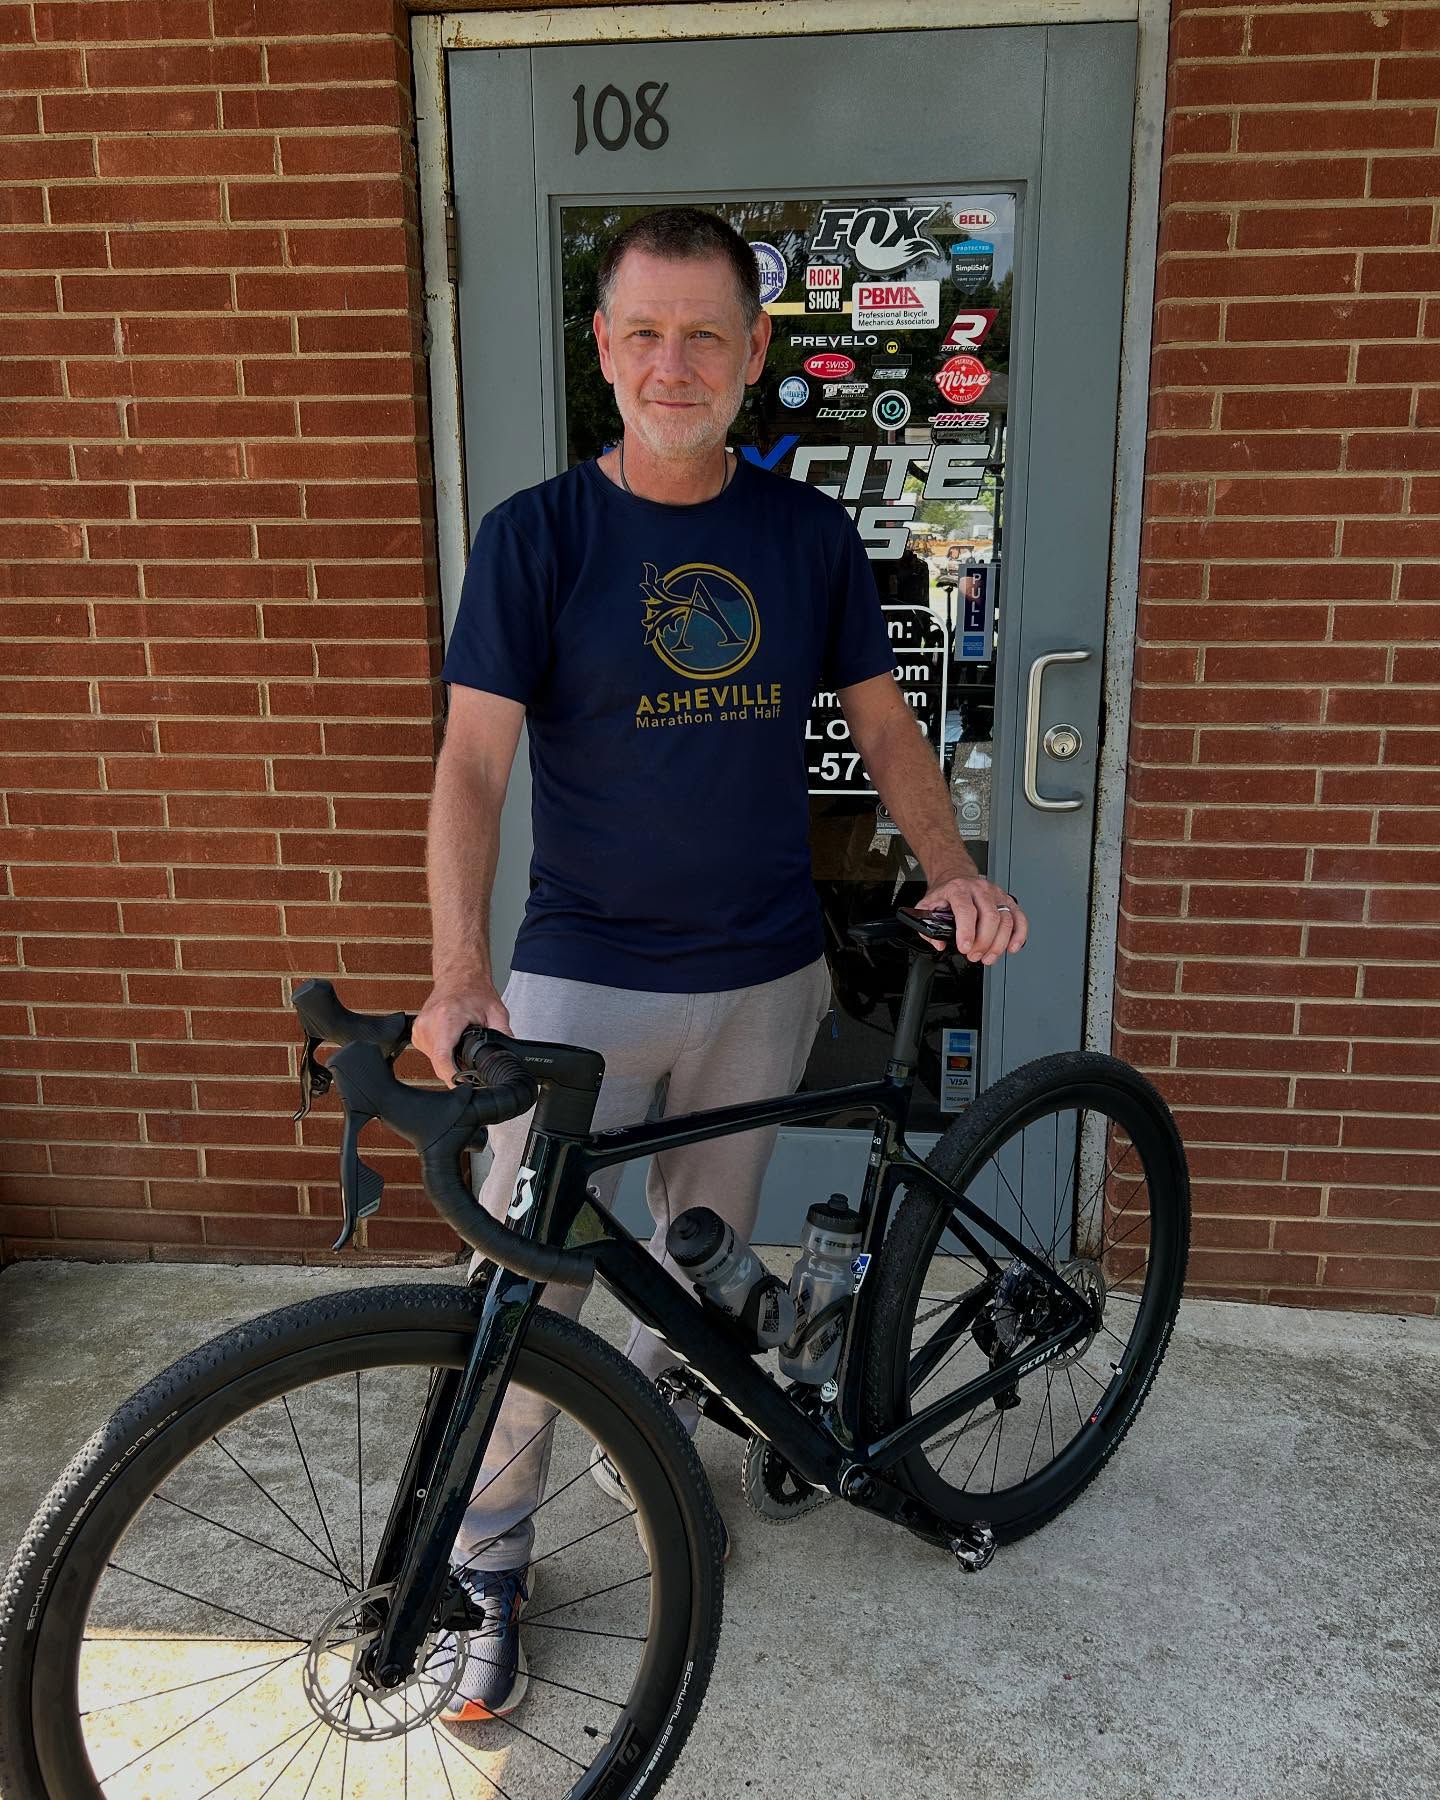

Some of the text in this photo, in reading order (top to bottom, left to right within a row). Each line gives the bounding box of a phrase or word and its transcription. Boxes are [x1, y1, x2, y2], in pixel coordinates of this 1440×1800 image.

[572, 81, 669, 155] 108
[959, 213, 990, 226] BELL
[811, 206, 942, 256] FOX
[809, 268, 840, 287] ROCK
[955, 264, 990, 273] SimpliSafe
[808, 290, 840, 310] SHOX
[858, 286, 921, 305] PBMA
[858, 310, 928, 321] Professional Bicycle
[858, 318, 935, 327] Mechanics Association
[790, 334, 878, 348] PREVELO
[825, 360, 850, 370] SWISS
[816, 407, 868, 421] hope
[934, 412, 987, 421] JAMIS
[935, 420, 987, 428] BIKES
[970, 573, 982, 627] PULL
[636, 683, 782, 716] ASHEVILLE
[636, 704, 782, 729] Marathon and Half
[808, 752, 872, 782] -57
[949, 1077, 969, 1086] VISA
[1017, 1344, 1061, 1376] SCOTT
[26, 1535, 69, 1632] SCHWALBE
[661, 1660, 695, 1745] SCHWALBE
